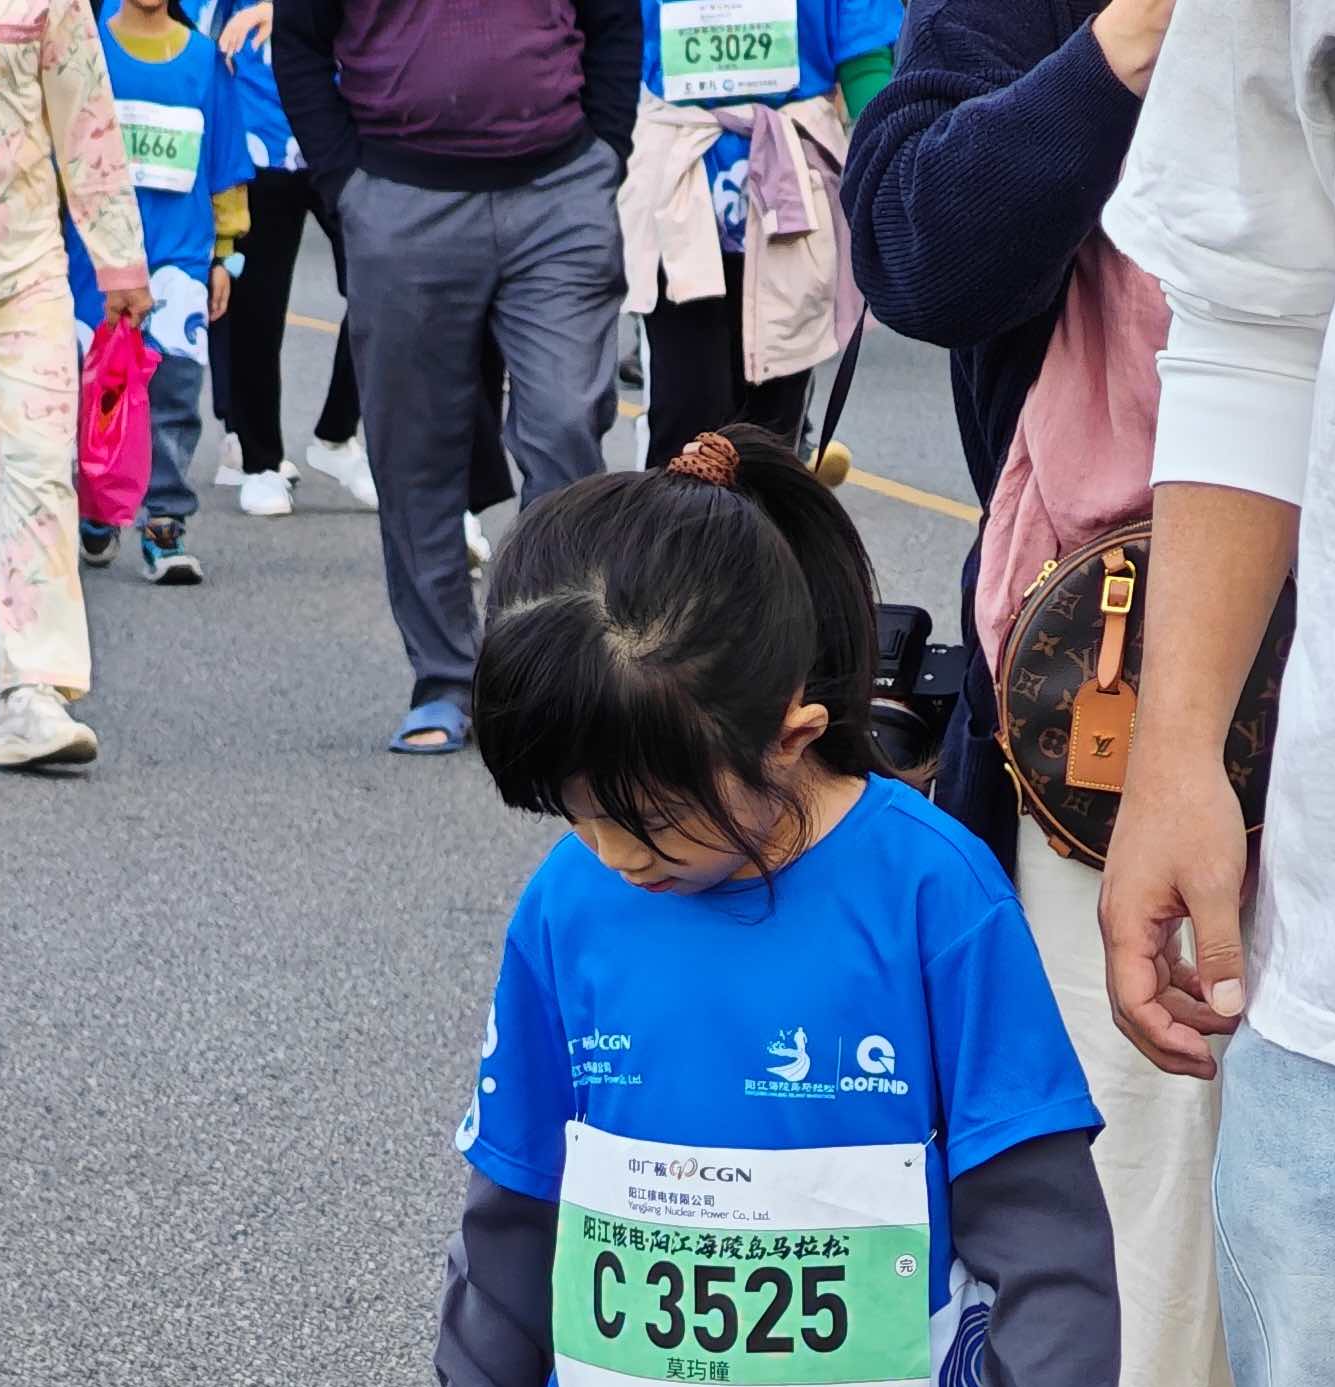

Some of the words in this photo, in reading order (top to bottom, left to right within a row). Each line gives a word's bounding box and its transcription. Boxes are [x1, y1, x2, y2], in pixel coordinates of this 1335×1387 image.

[685, 37, 701, 64] C
[710, 32, 773, 62] 3029
[131, 130, 177, 159] 1666
[599, 1034, 632, 1051] CGN
[840, 1077, 909, 1095] GOFIND
[628, 1158, 667, 1177] 中广核
[699, 1166, 752, 1183] CGN
[628, 1186, 715, 1207] 阳江核电有限公司
[664, 1205, 696, 1217] Nuclear
[701, 1208, 729, 1220] Power
[899, 1258, 913, 1273] 完
[593, 1250, 626, 1339] C
[645, 1260, 848, 1354] 3525
